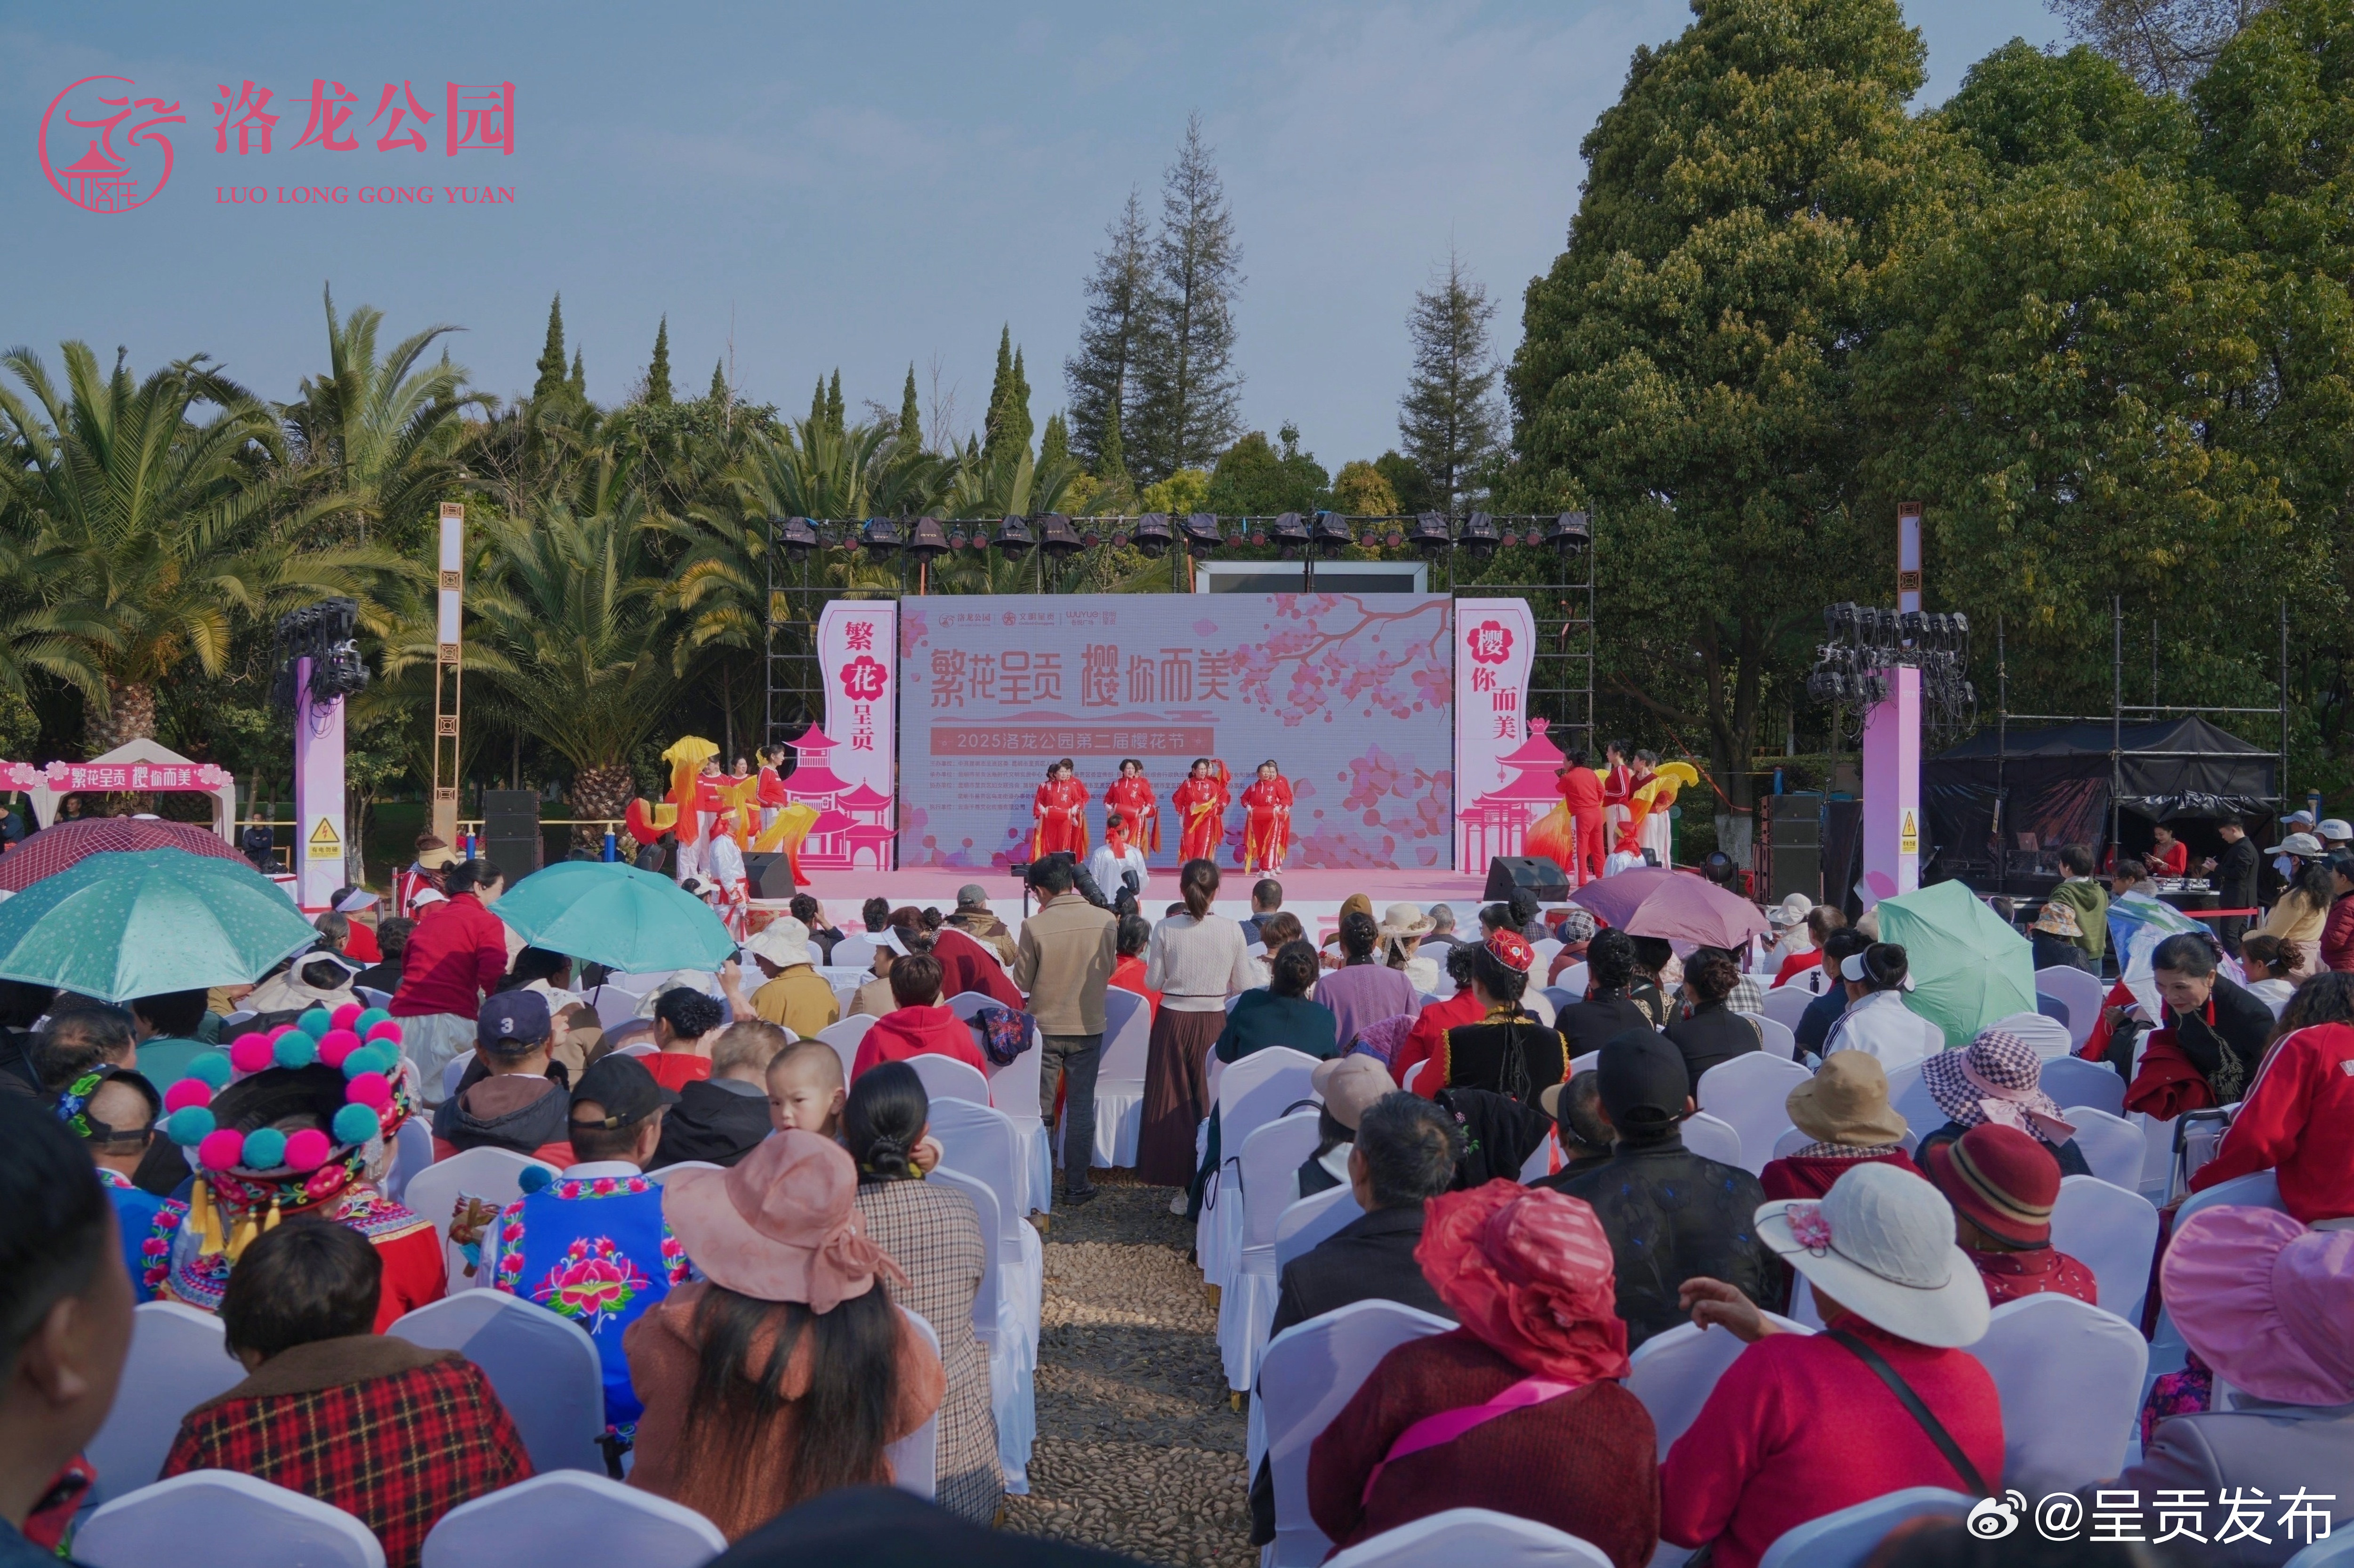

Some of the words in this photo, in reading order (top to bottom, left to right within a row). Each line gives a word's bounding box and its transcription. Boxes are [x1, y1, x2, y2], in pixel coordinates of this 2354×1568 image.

[958, 613, 991, 622] 洛龙公园
[1019, 612, 1055, 620] 文明呈贡
[930, 648, 1062, 708] 繁花呈贡
[1080, 643, 1230, 707] 樱你而美
[1471, 628, 1517, 740] 樱你而美
[845, 621, 878, 751] 繁花呈贡
[957, 732, 1185, 749] 2025洛龙公园第二届樱花节
[72, 767, 126, 788] 繁花呈贡
[132, 766, 191, 788] 樱你而美
[501, 1017, 514, 1033] 3
